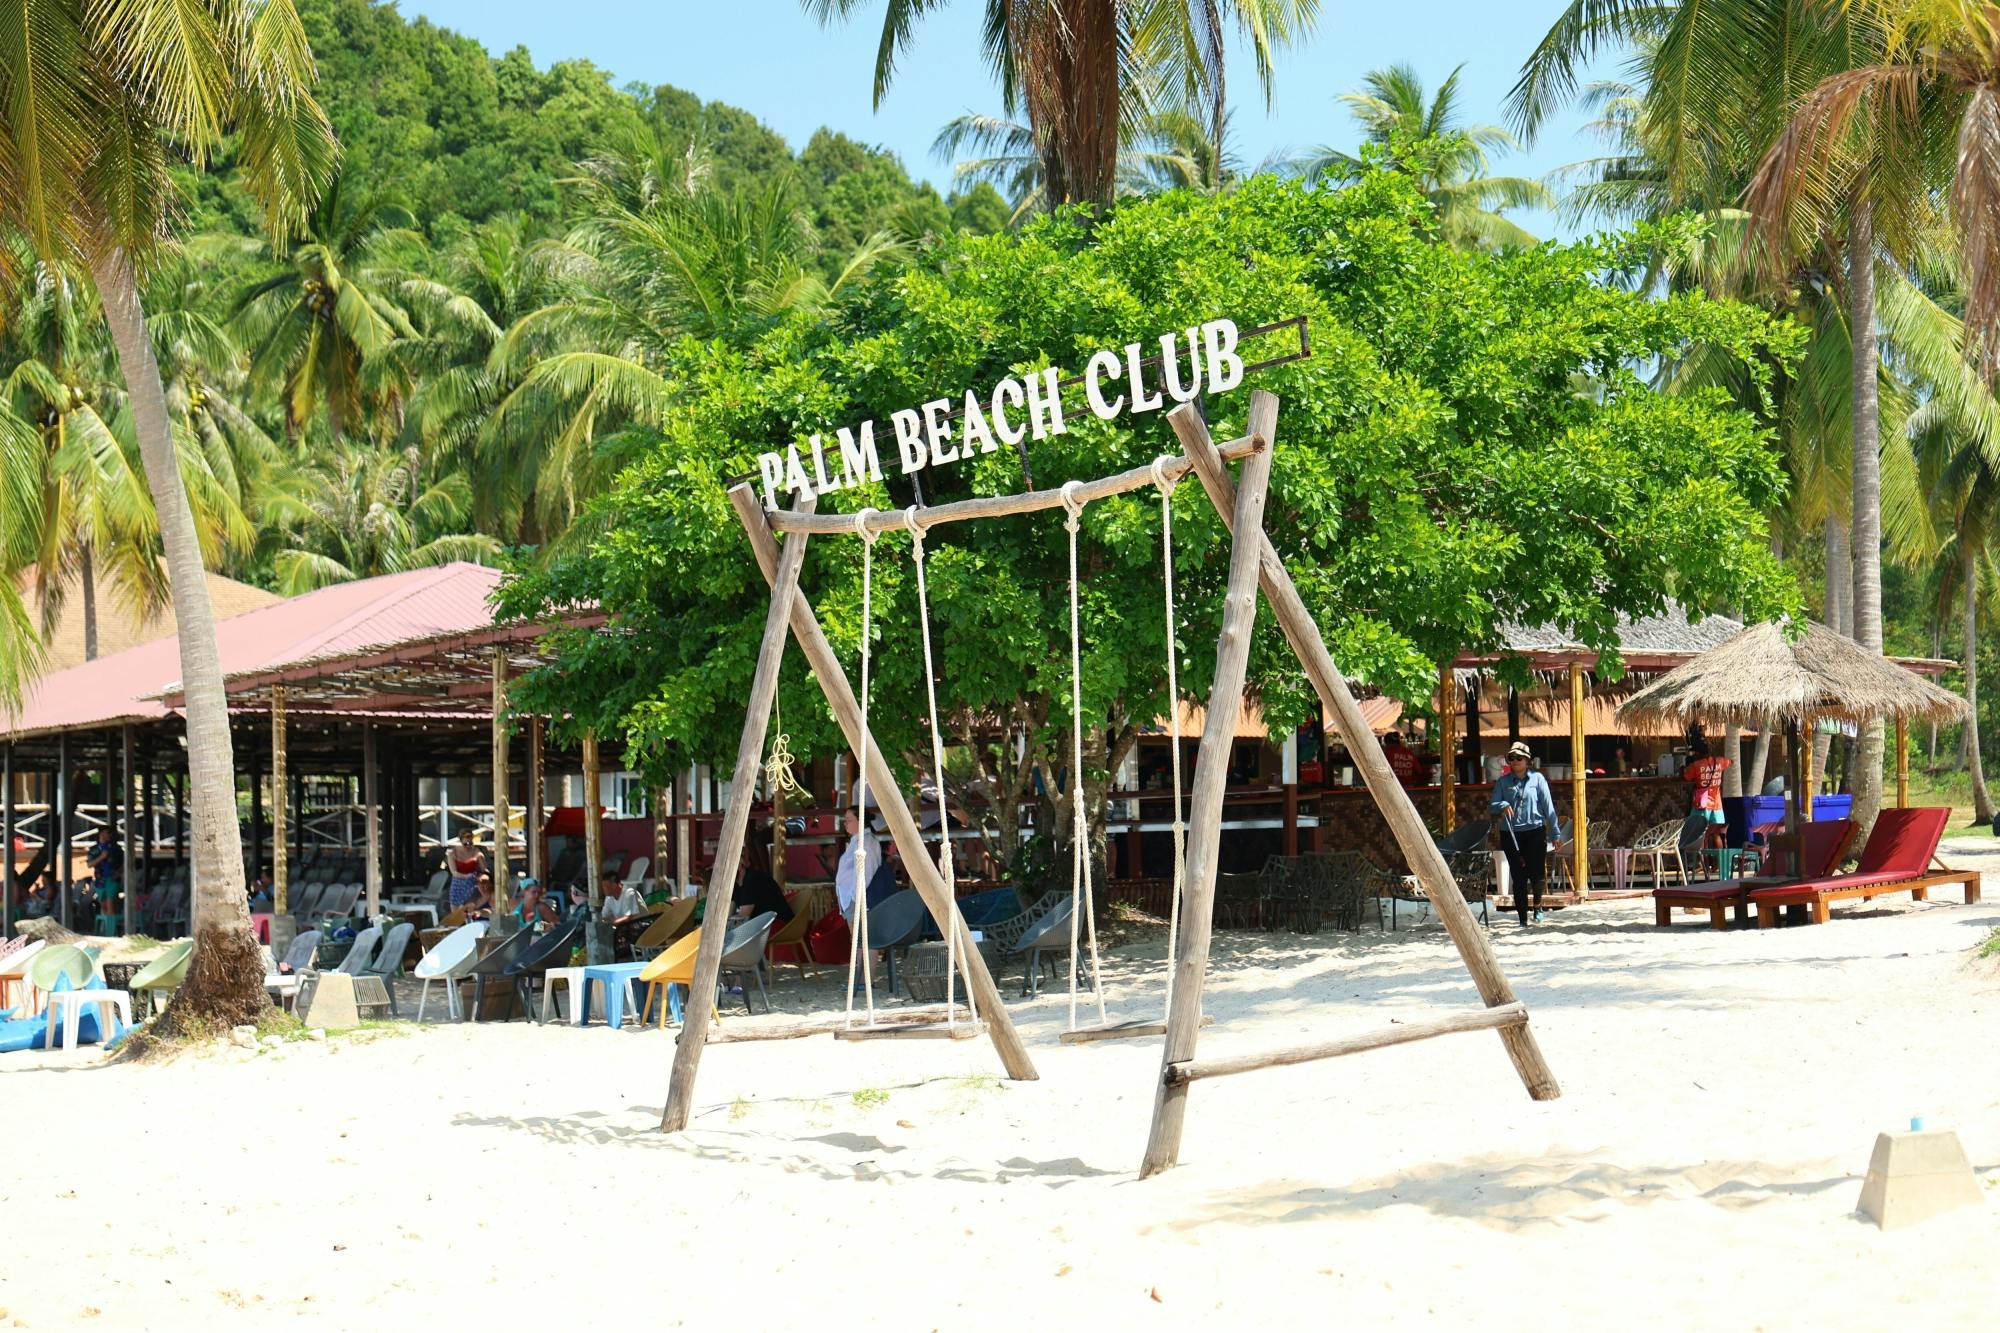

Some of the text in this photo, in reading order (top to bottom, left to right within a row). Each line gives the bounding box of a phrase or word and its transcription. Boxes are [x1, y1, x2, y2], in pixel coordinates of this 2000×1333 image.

[758, 319, 1244, 512] PALM BEACH CLUB
